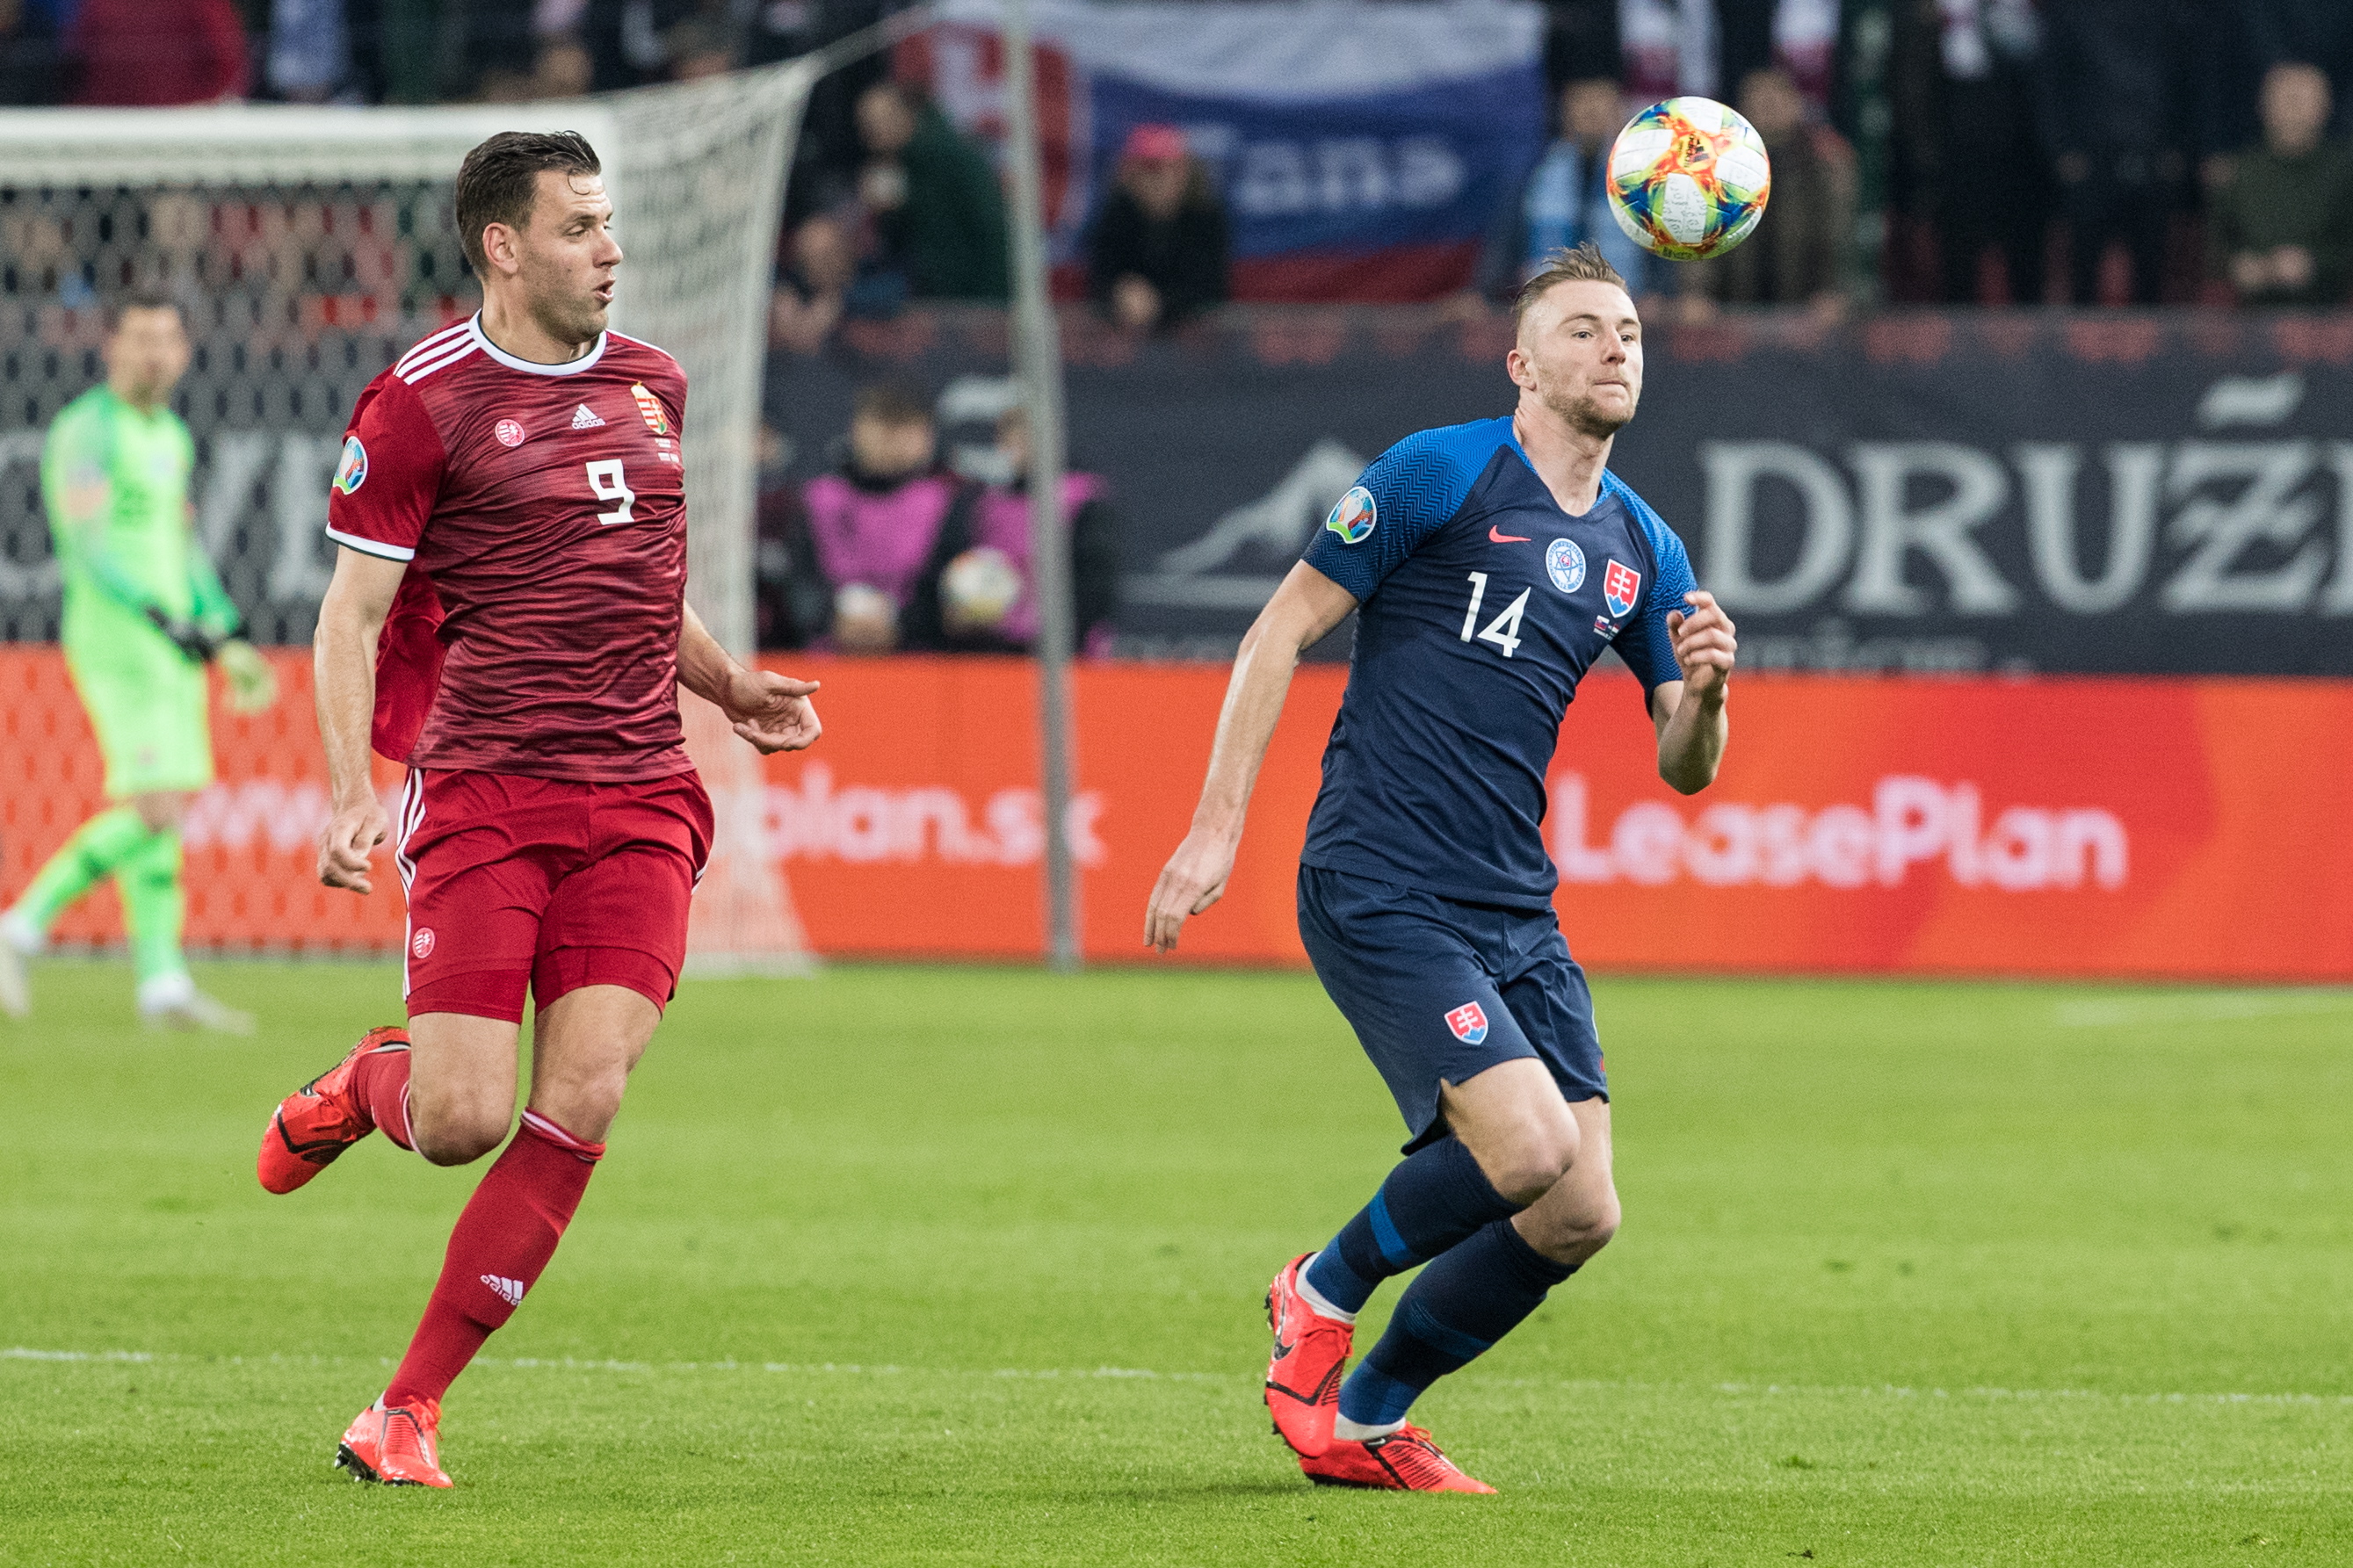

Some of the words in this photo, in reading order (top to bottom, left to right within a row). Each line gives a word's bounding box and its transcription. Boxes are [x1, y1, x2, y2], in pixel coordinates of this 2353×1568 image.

[572, 417, 606, 430] adidas
[586, 459, 635, 525] 9
[1460, 571, 1531, 658] 14
[1552, 771, 2126, 889] LeasePlan
